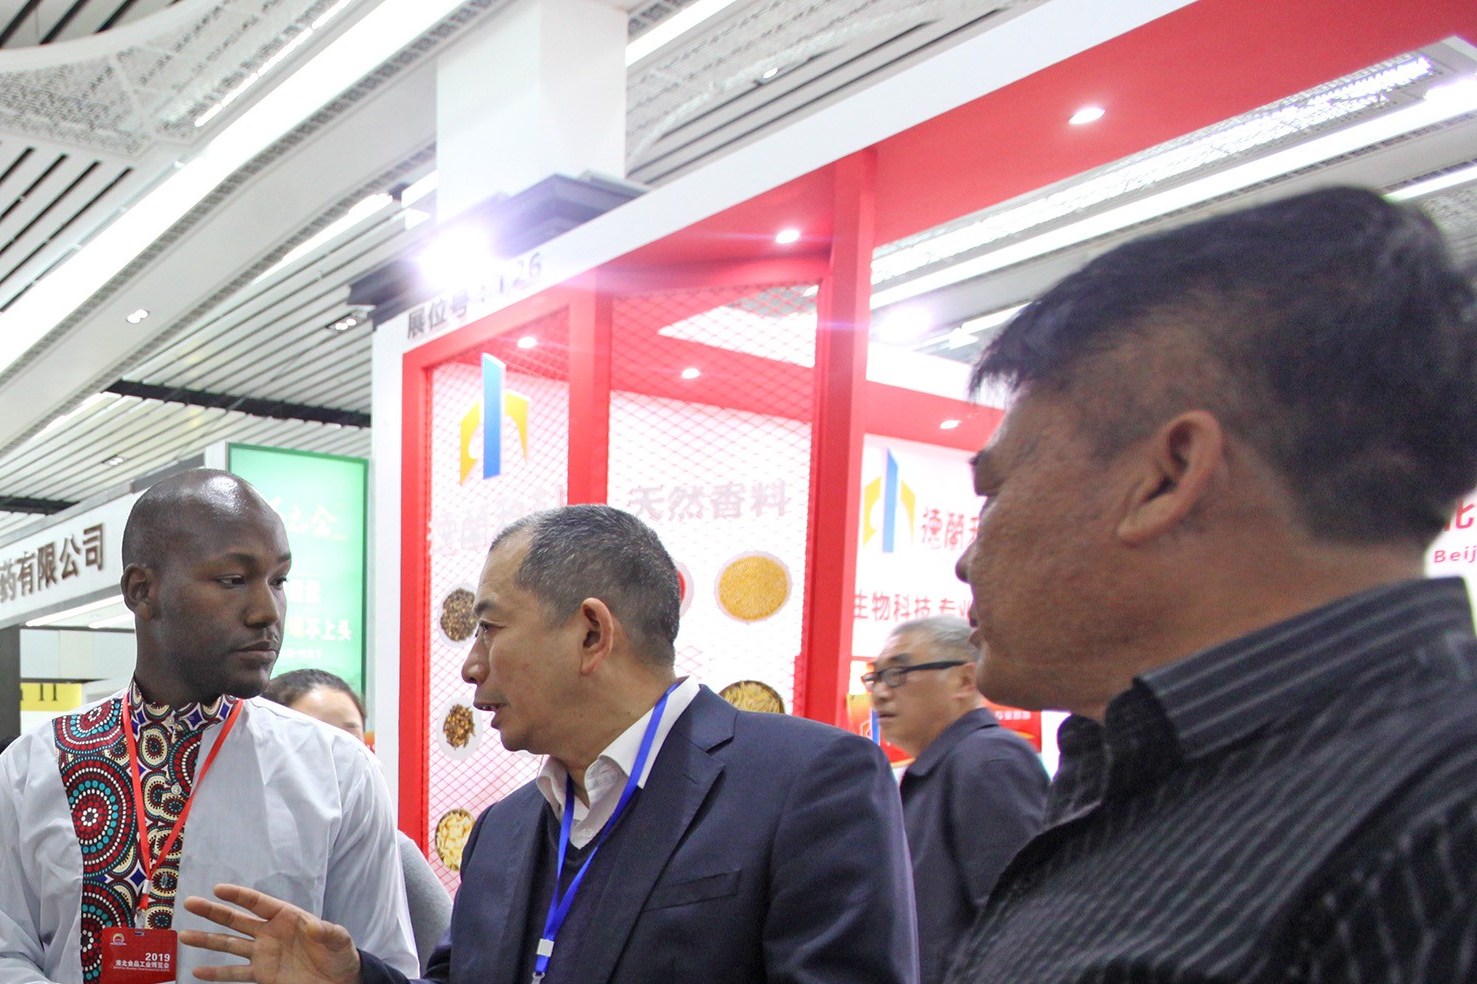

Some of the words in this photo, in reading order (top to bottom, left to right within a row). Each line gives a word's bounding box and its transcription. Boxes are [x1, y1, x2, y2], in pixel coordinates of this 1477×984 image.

[629, 480, 791, 520] 天然香料
[145, 952, 171, 962] 2019
